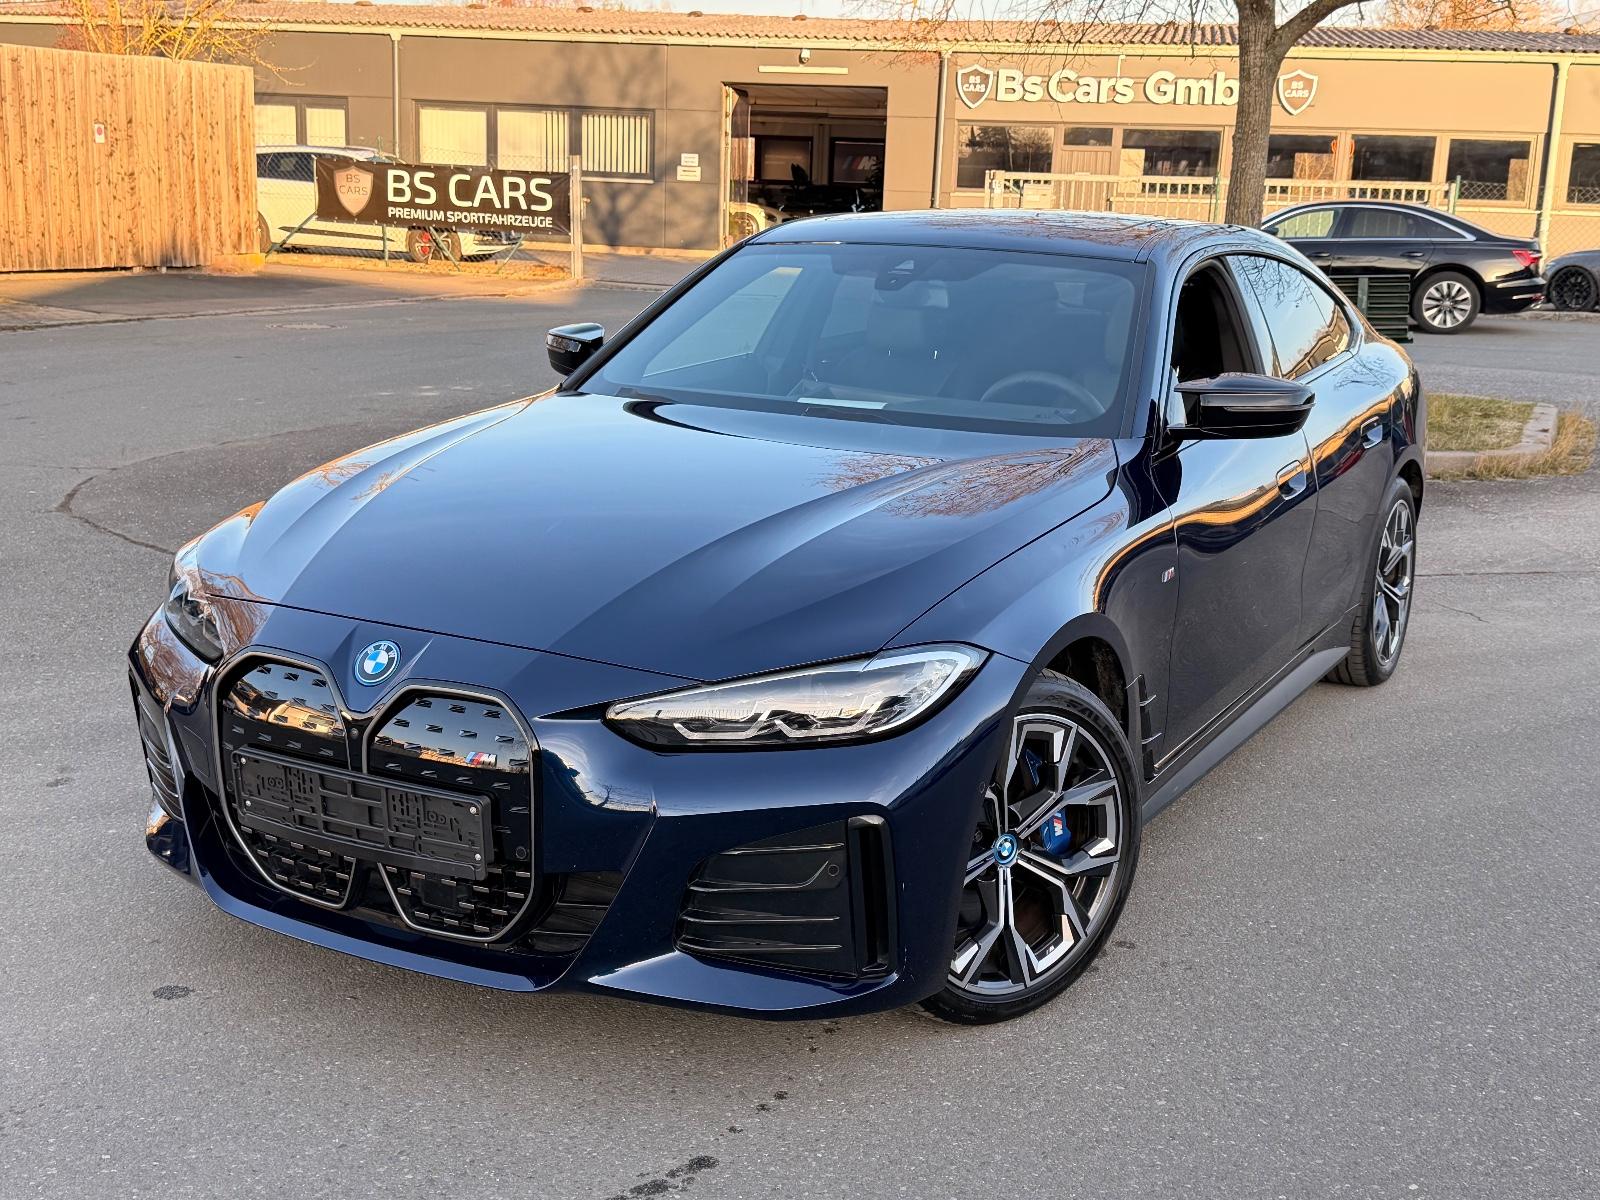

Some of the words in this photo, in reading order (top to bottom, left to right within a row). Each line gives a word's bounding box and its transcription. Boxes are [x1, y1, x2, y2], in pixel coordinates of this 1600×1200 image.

[963, 84, 986, 92] CARS
[996, 68, 1043, 102] Bs
[1048, 69, 1135, 103] Cars
[1145, 70, 1240, 105] Gmb
[1291, 80, 1304, 90] BS
[1284, 89, 1309, 98] CARS
[345, 173, 361, 183] BS
[339, 184, 369, 196] CARS
[387, 169, 438, 205] BS
[449, 174, 553, 212] CARS
[387, 206, 445, 222] PREMIUM
[447, 211, 553, 228] SPORTFAHRZEUGE
